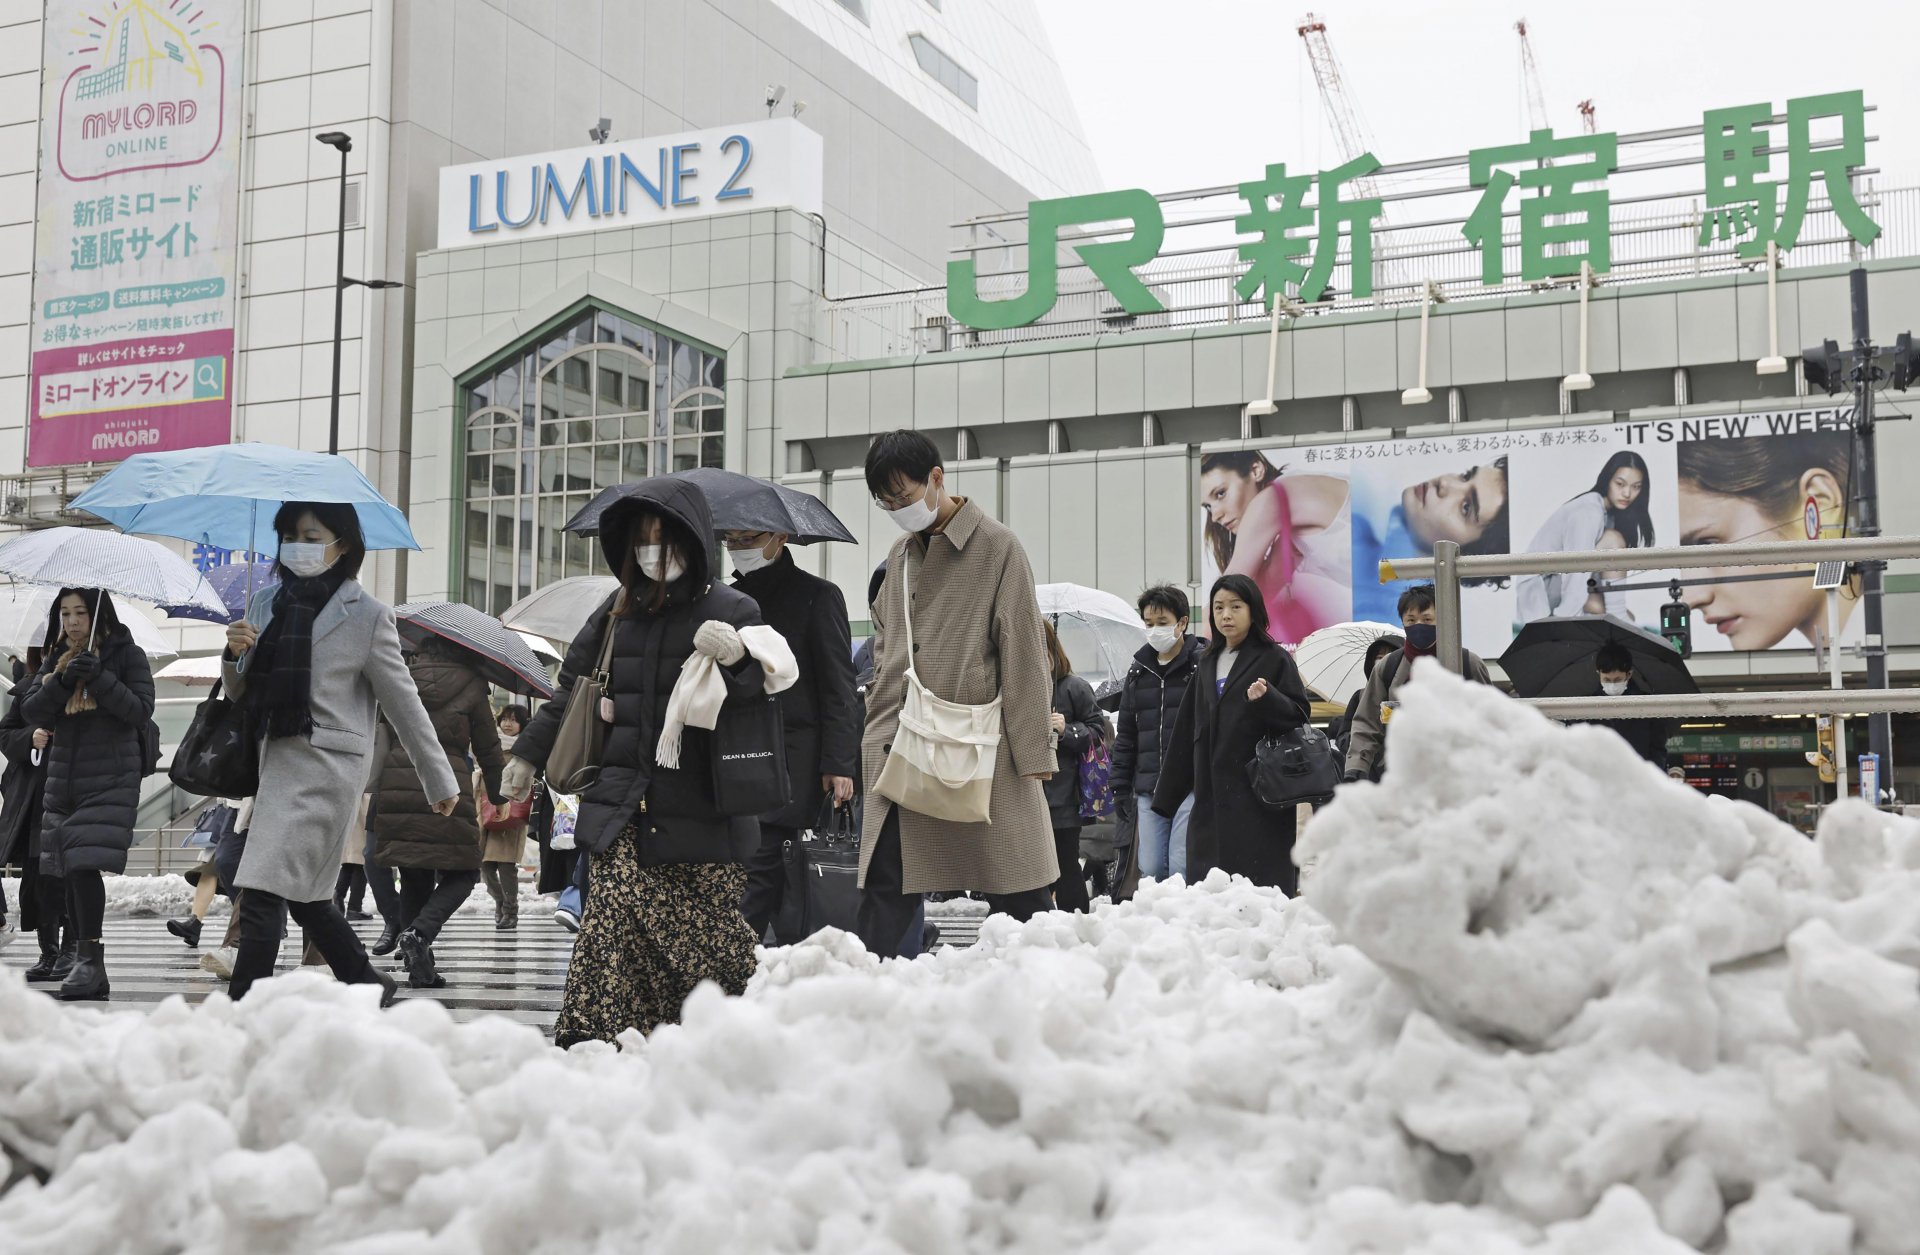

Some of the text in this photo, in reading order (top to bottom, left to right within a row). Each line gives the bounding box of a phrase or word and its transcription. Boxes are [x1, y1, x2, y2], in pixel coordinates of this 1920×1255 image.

[82, 99, 198, 140] MYLORD
[105, 136, 168, 159] ONLINE
[469, 134, 754, 233] LUMINE 2
[73, 184, 203, 228] 新宿ミロード
[70, 221, 199, 272] 通販サイト
[77, 342, 186, 367] 詳しくはサイトをチェック
[44, 370, 189, 405] ミロードオンライン
[104, 418, 149, 430] shinjuku
[1766, 408, 1856, 437] WEEK
[92, 428, 160, 450] MYLORD
